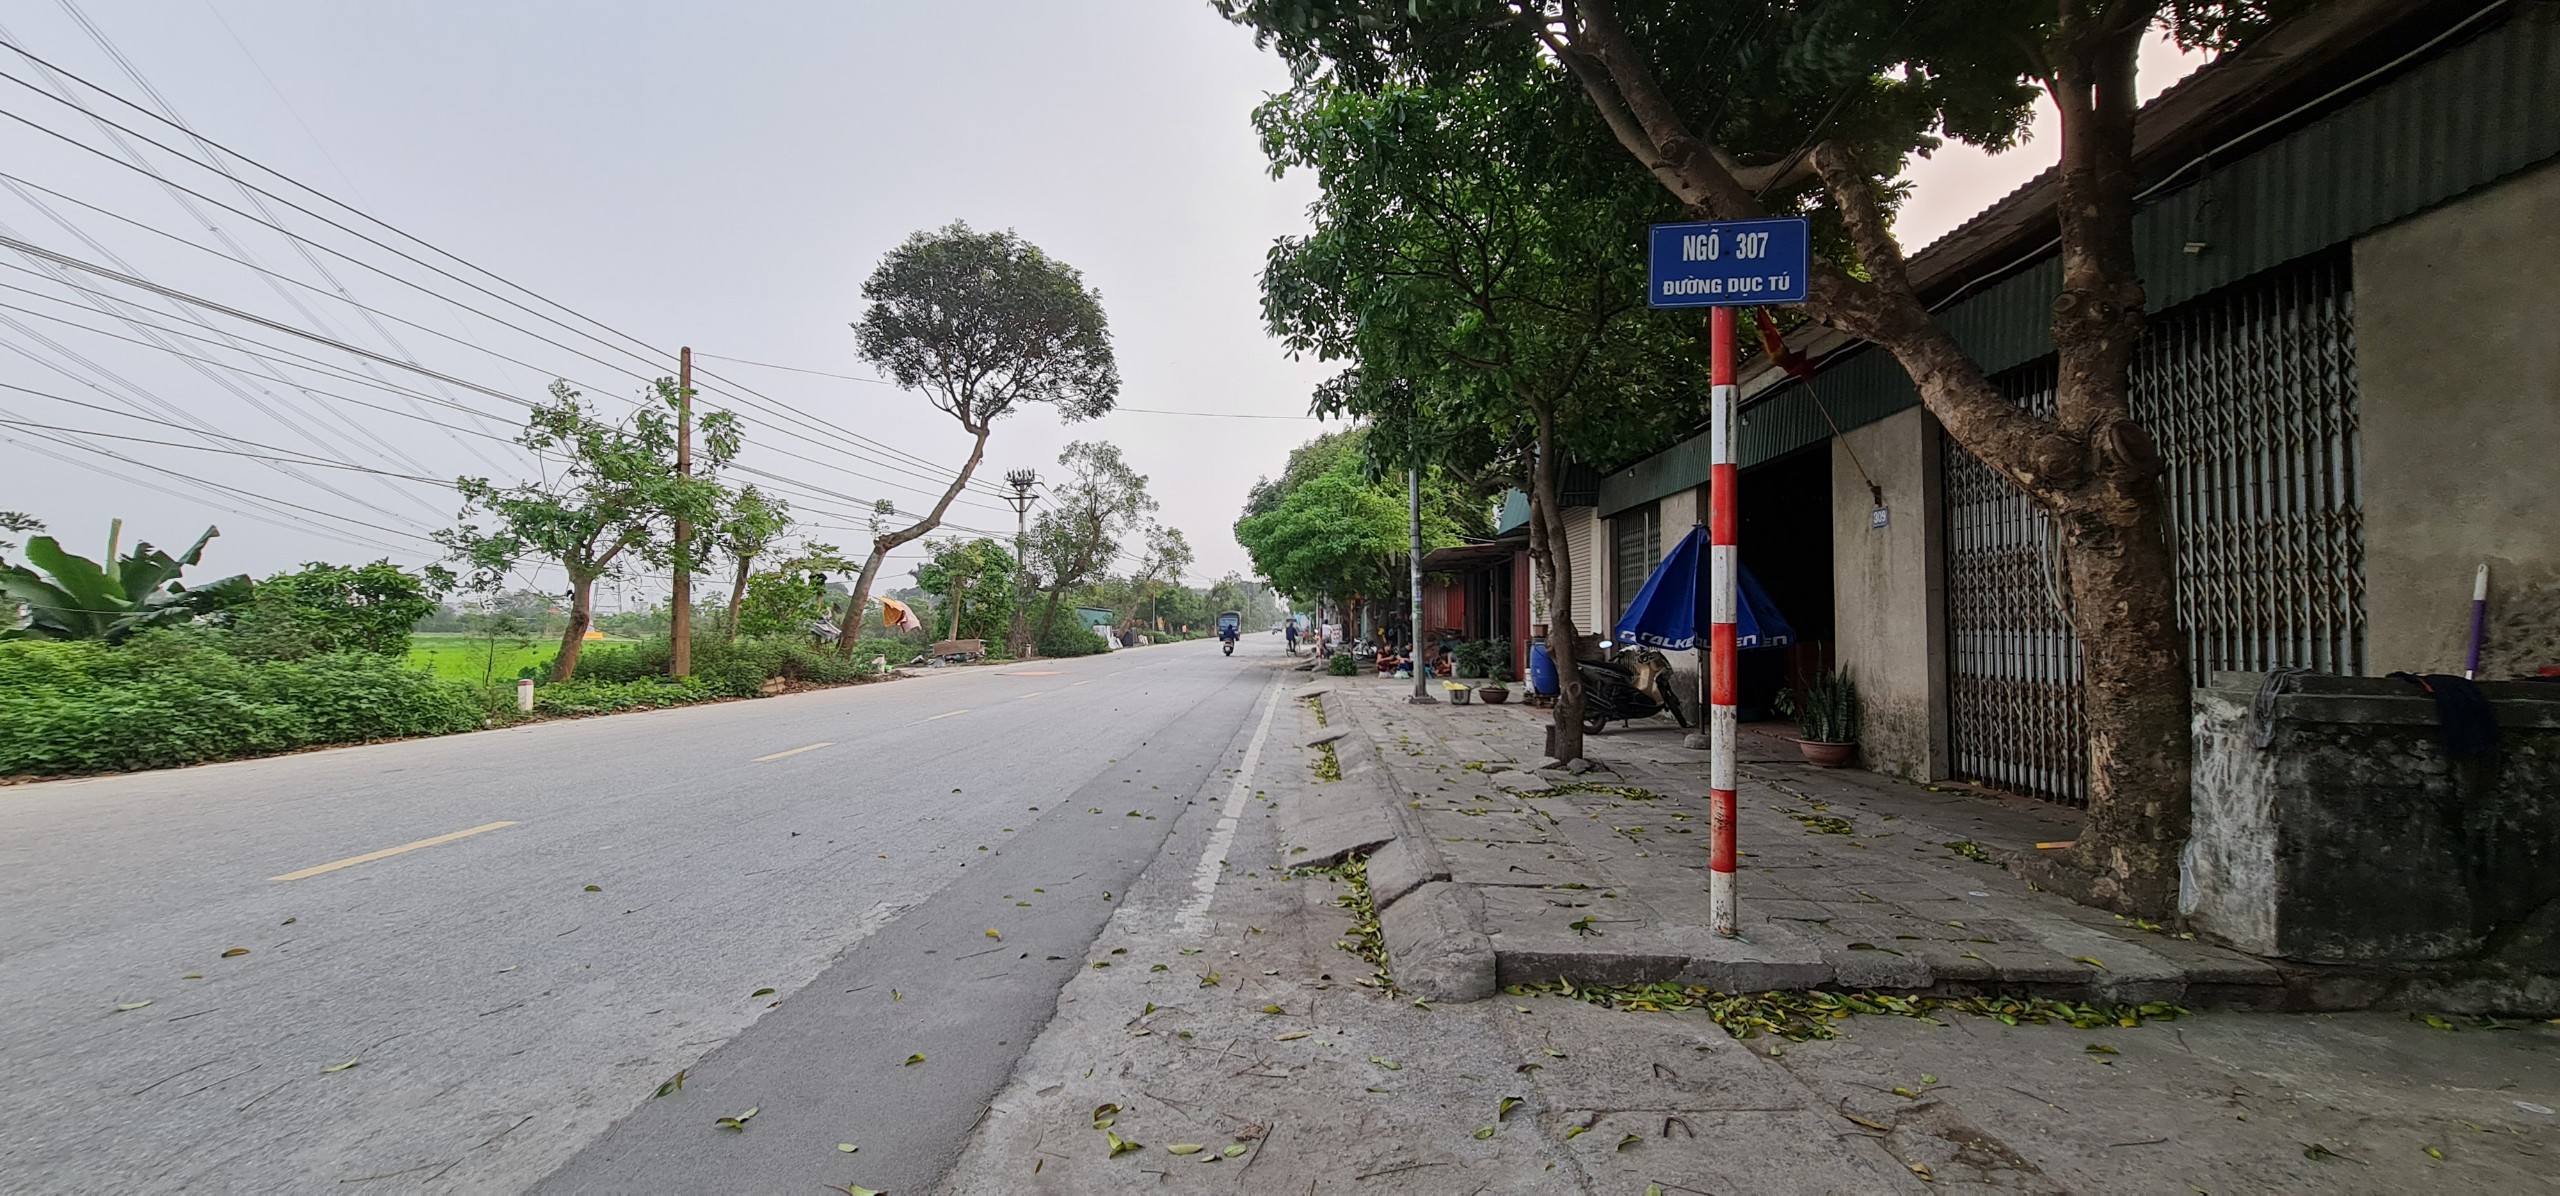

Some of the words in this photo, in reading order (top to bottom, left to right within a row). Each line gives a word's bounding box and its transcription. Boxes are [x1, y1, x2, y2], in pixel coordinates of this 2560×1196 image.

[1682, 229, 1719, 261] NGÕ
[1736, 232, 1769, 260] 307
[1663, 275, 1722, 295] ĐƯỜNG
[1727, 276, 1763, 297] DỤC
[1768, 271, 1790, 291] TÚ
[1873, 511, 1886, 524] 309
[1640, 632, 1695, 649] FALKE
